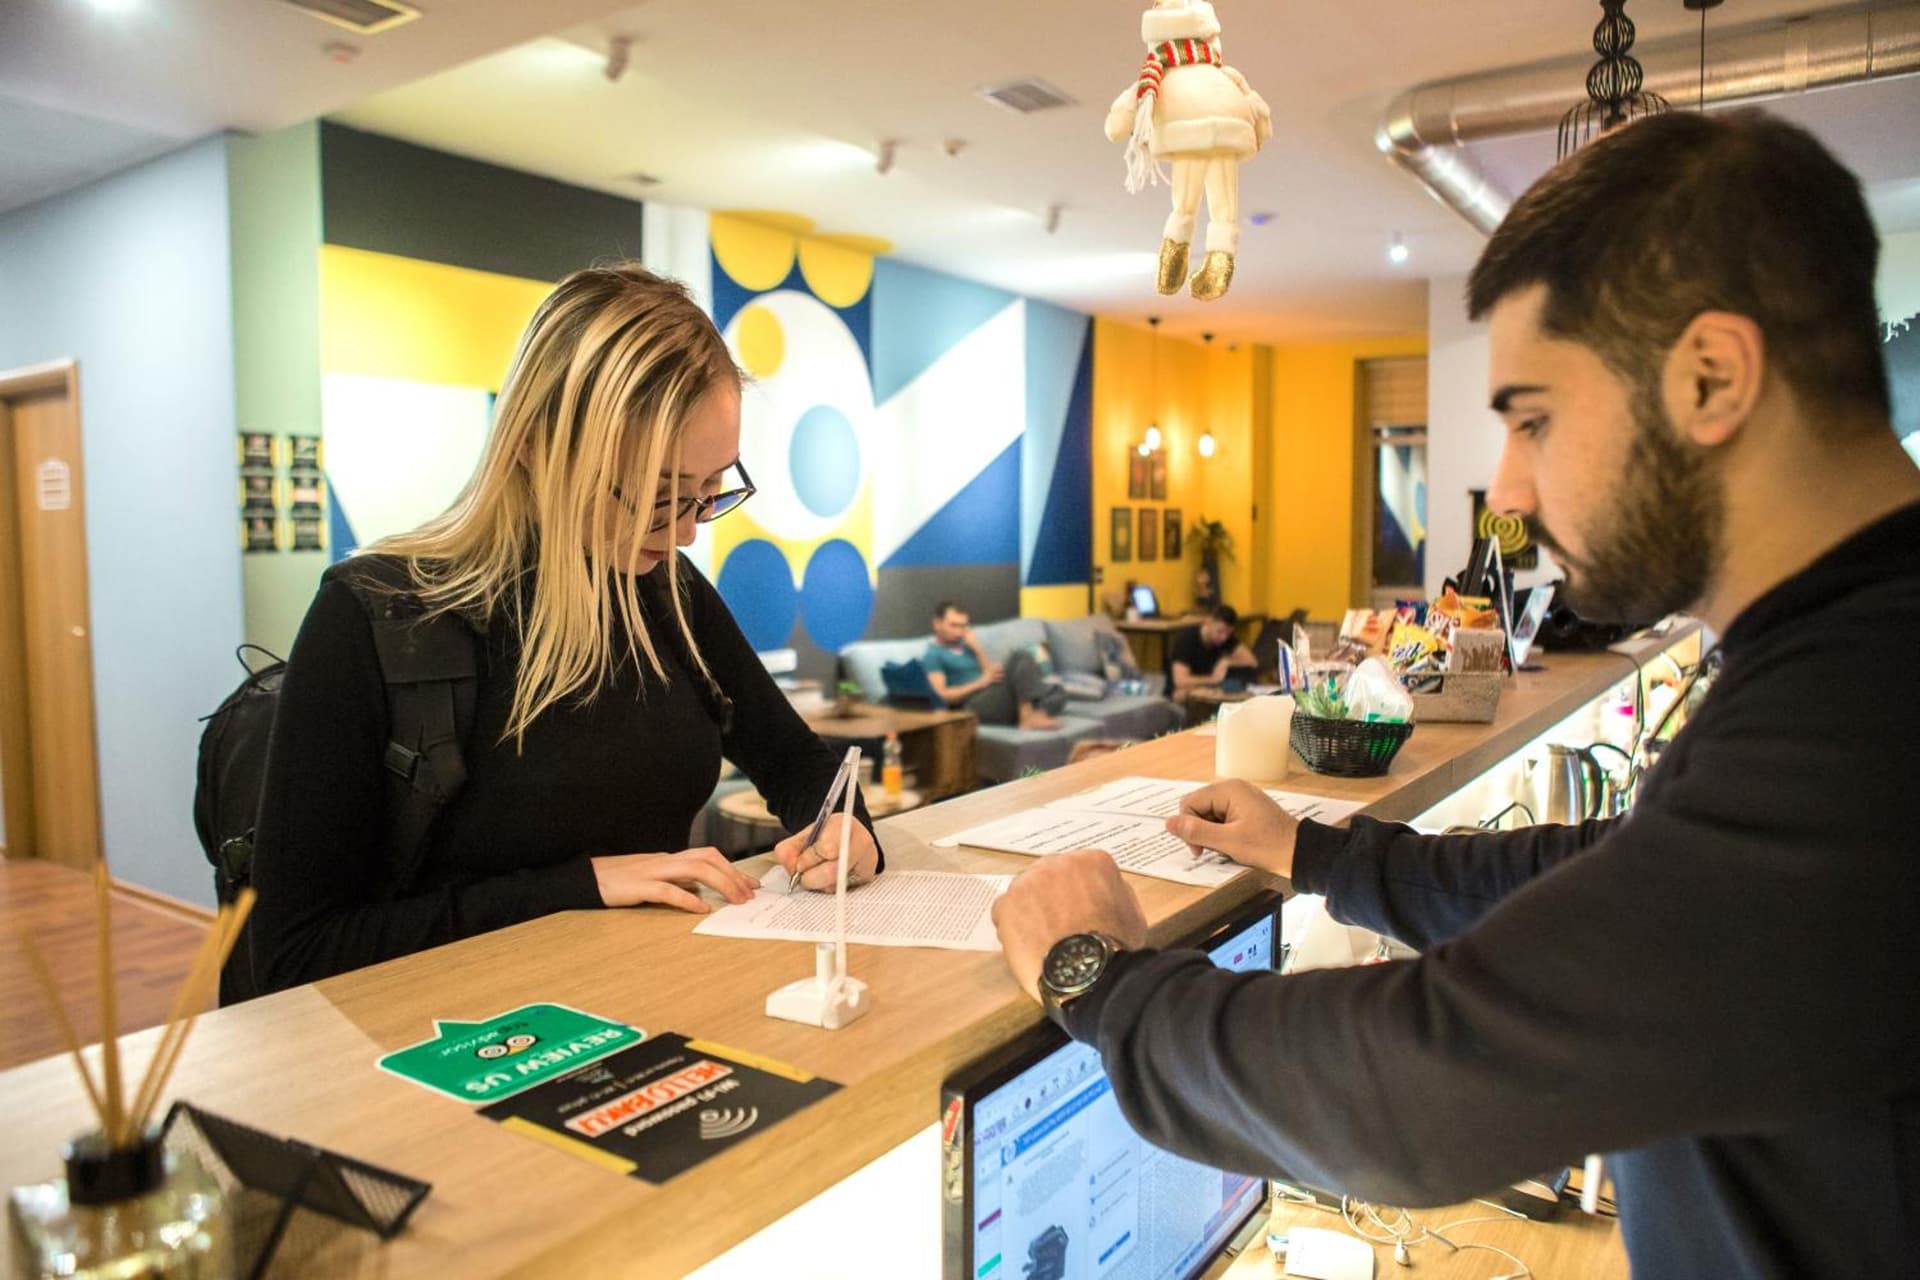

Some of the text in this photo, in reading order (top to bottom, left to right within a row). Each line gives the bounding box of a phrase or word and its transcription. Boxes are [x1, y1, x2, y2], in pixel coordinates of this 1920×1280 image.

[515, 1028, 623, 1075] REVIEW
[465, 1072, 512, 1093] US
[622, 1096, 699, 1137] password
